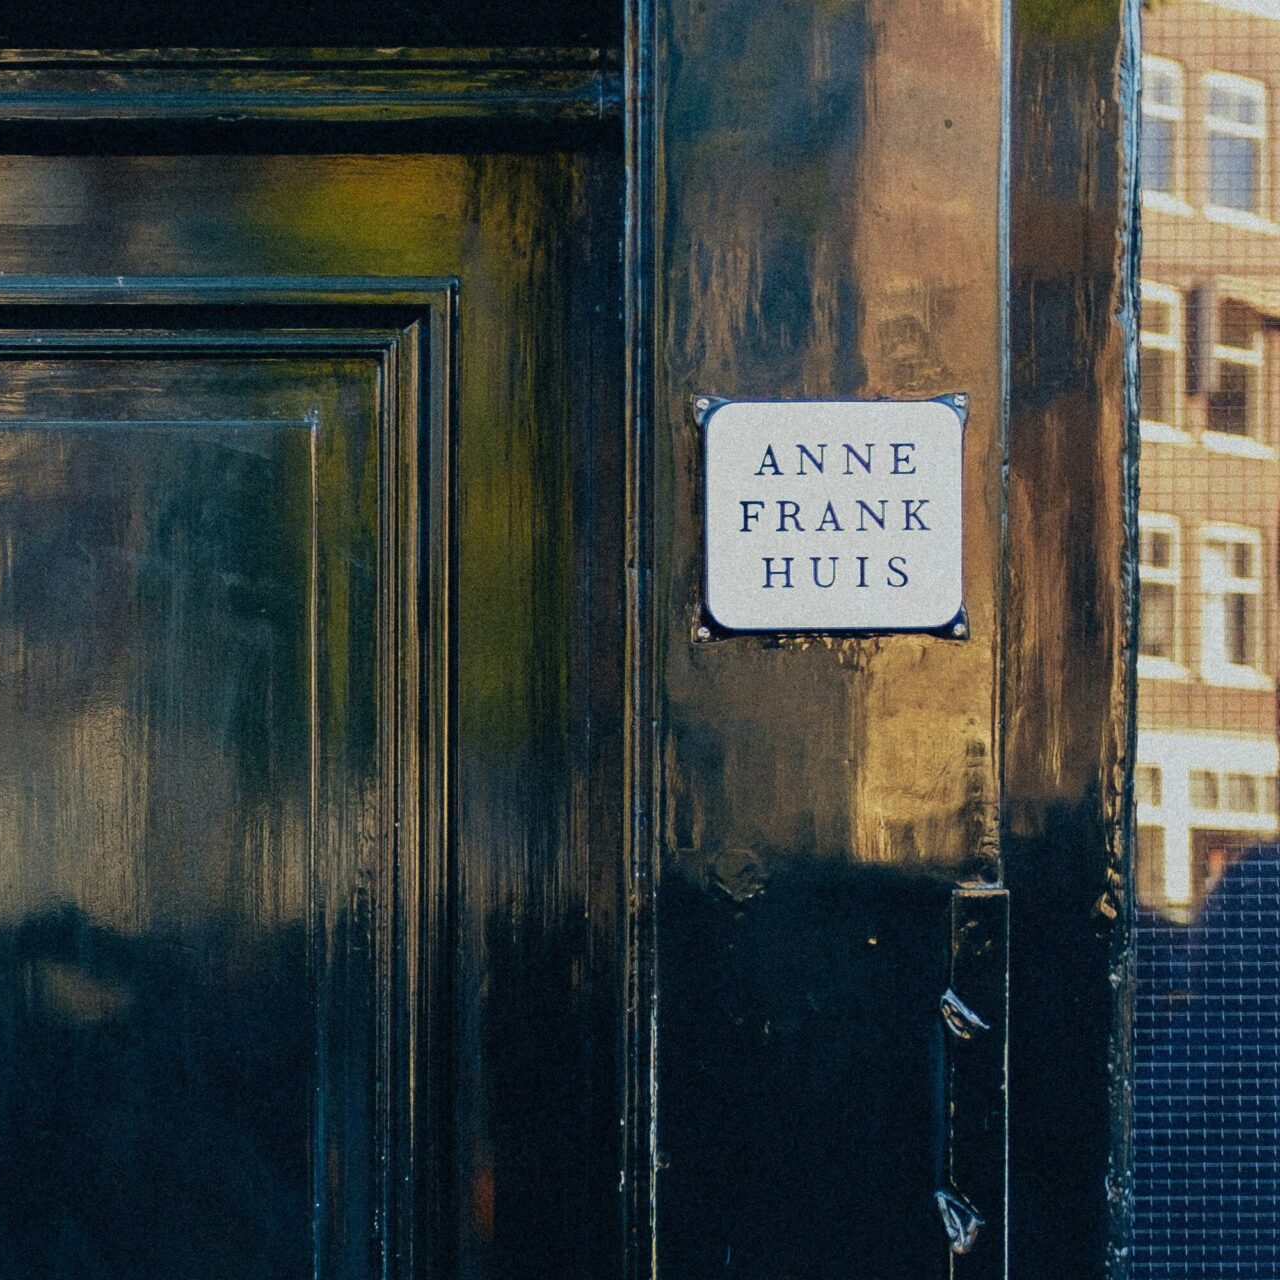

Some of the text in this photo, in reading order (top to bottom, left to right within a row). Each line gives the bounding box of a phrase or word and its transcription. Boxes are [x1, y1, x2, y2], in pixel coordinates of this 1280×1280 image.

[753, 442, 917, 476] ANNE
[738, 499, 932, 533] FRANK
[761, 556, 910, 589] HUIS
